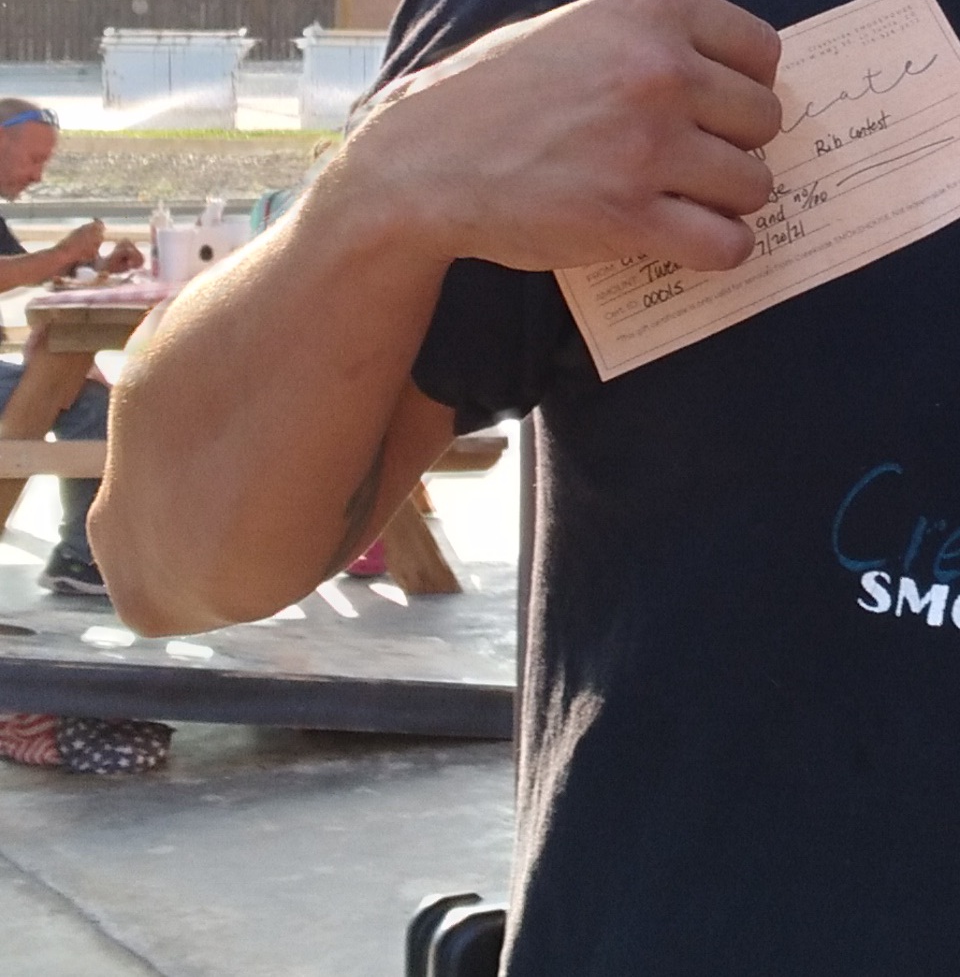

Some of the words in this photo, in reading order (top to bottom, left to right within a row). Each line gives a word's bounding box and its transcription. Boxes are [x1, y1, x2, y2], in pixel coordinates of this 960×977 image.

[814, 133, 843, 157] Rib
[756, 204, 786, 228] and
[643, 280, 684, 308] 00015
[754, 219, 805, 256] 7/20/21
